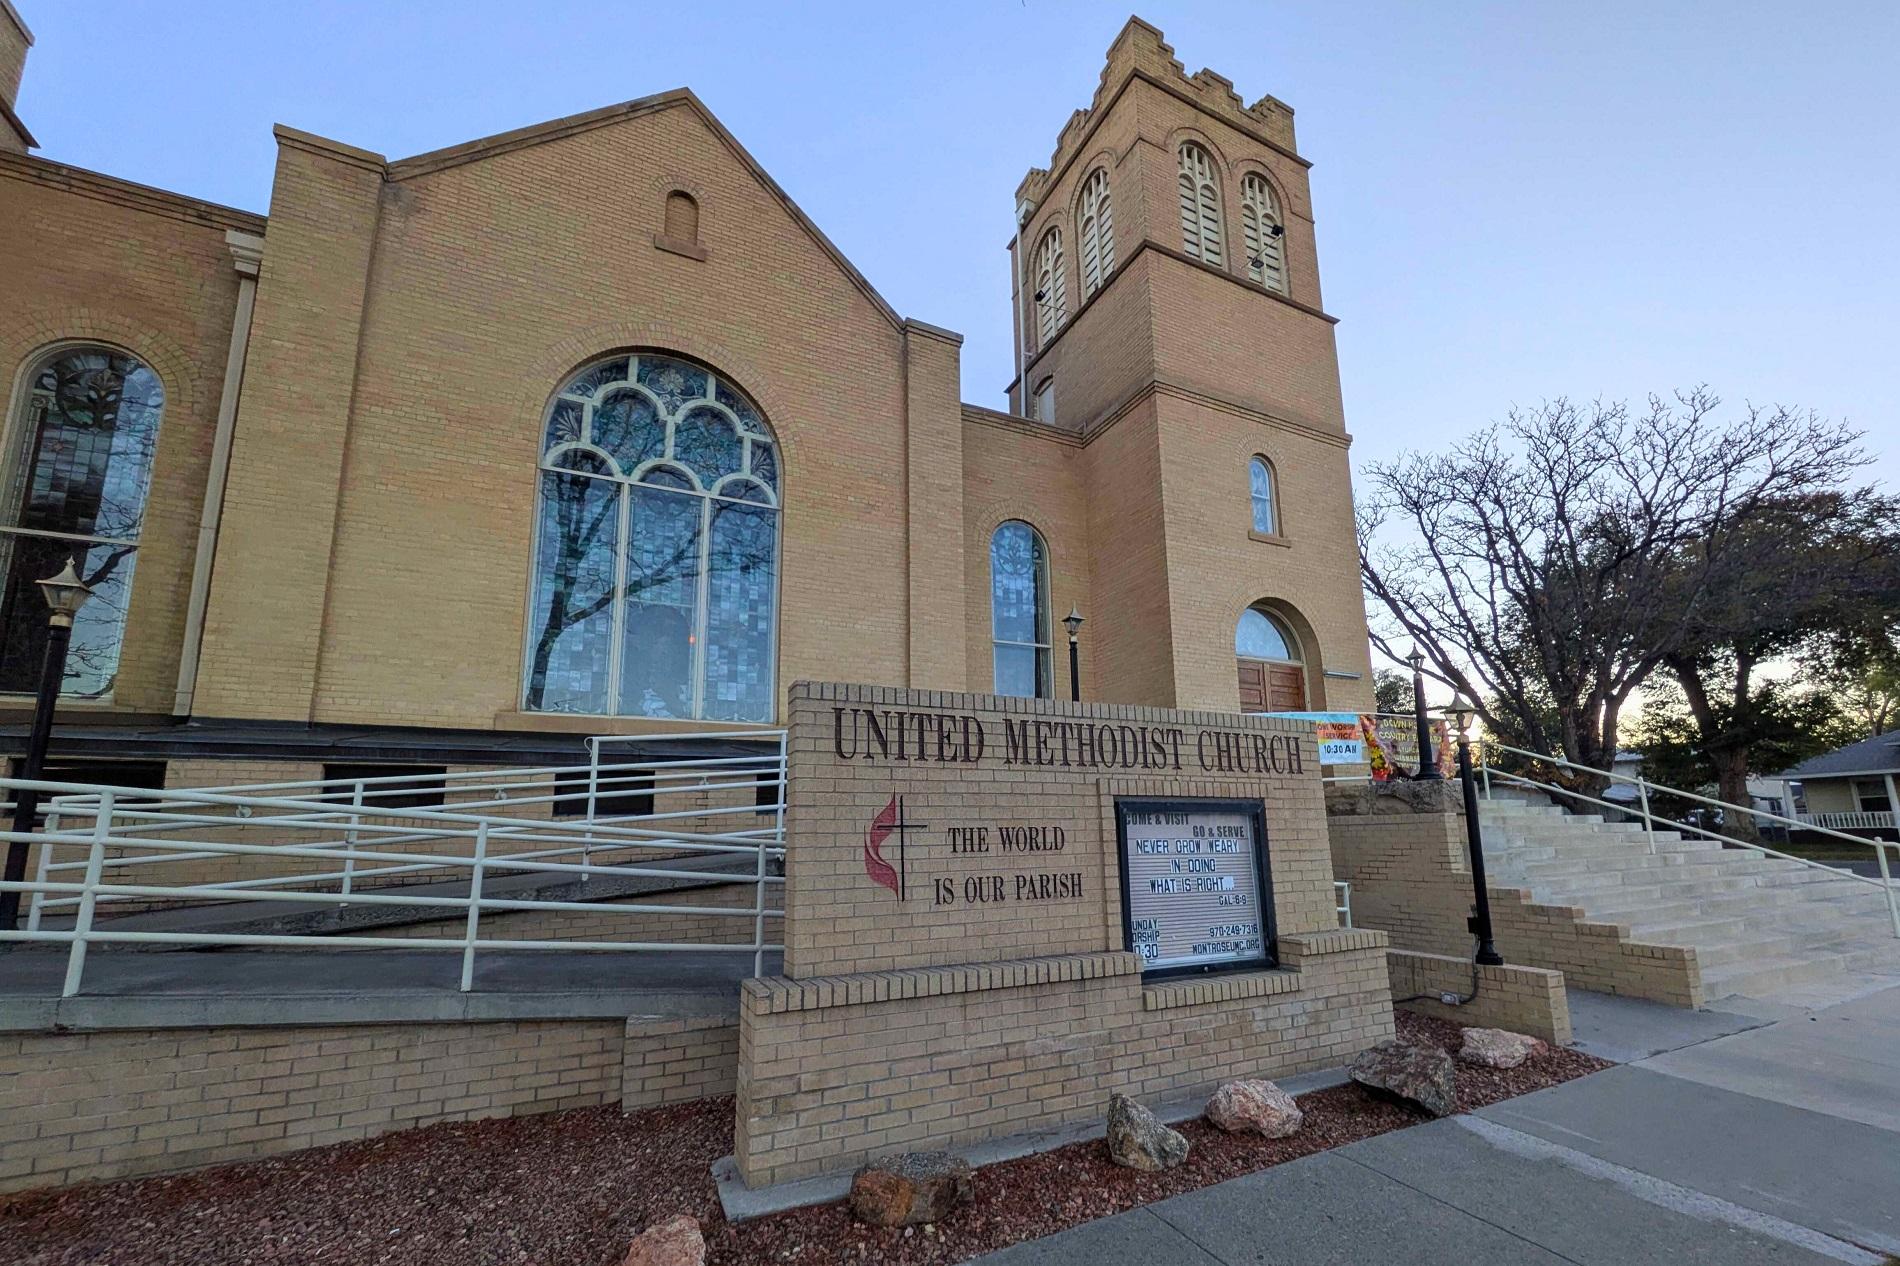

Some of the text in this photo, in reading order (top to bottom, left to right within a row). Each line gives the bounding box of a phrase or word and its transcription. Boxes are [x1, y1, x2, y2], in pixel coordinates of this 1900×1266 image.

[832, 707, 1305, 775] UNITED METHODIST CHURCH
[1324, 745, 1343, 754] 10:30
[1126, 813, 1190, 826] COME & VISIT
[948, 825, 1065, 853] THE WORLD
[1192, 826, 1245, 838] GO & SERVE
[1136, 839, 1239, 854] NEVER GROW WEARY
[1171, 859, 1216, 873] IN DOING
[934, 872, 1083, 905] IS OUR PARISH
[1149, 879, 1176, 893] WHAT
[1181, 879, 1192, 892] IS
[1219, 895, 1247, 905] GAL 6:9
[1132, 919, 1157, 930] UNDAY
[1132, 931, 1159, 943] ORSHIP
[1134, 944, 1158, 958] 0:30
[1192, 939, 1259, 954] MONTROSEUMC.ORG
